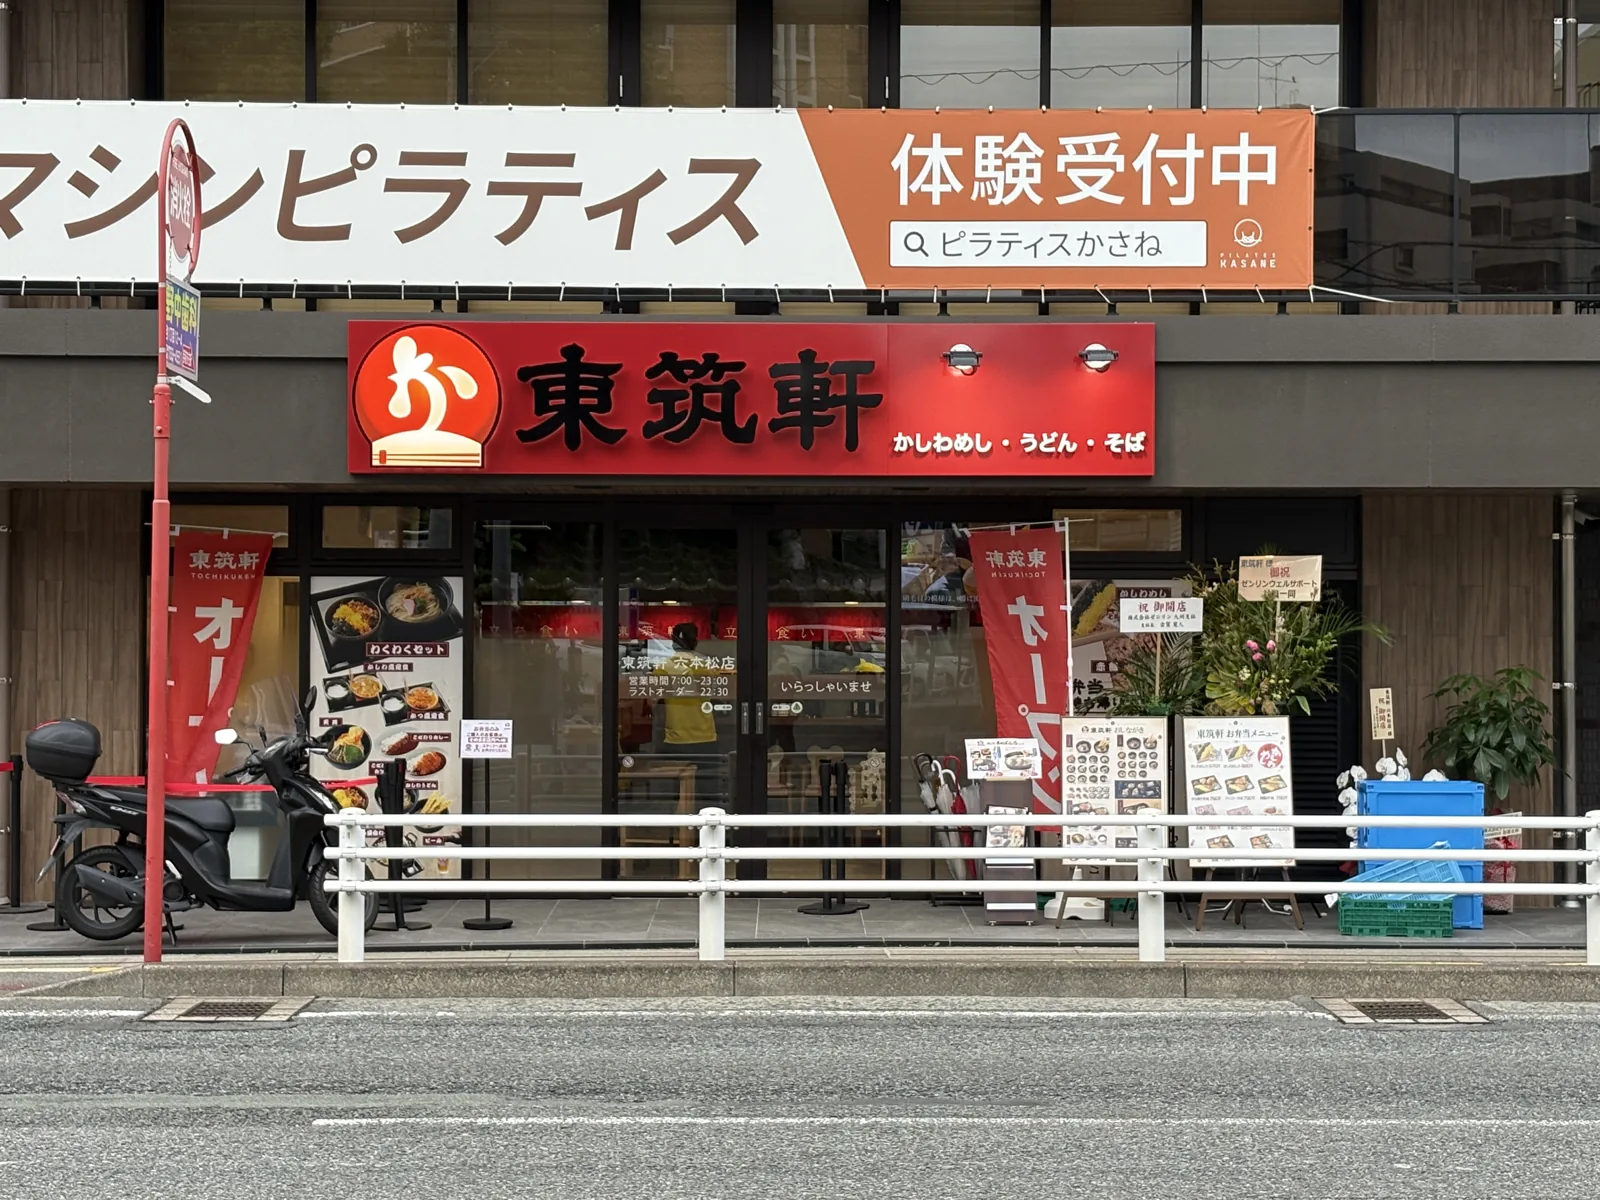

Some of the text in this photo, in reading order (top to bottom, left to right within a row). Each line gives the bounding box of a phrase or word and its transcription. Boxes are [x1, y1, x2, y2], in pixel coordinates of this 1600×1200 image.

[890, 131, 1278, 207] 体験受付中
[0, 143, 762, 252] マシンピラティス
[940, 229, 1163, 259] ピラティスかさね
[1220, 259, 1276, 268] KASANE
[516, 342, 882, 452] 東筑軒
[189, 549, 260, 570] 東筑軒
[191, 572, 256, 580] TOCHIKUKEN
[1270, 566, 1290, 578] 御祝
[1241, 580, 1317, 588] ゼンリンウェルサポート
[1120, 588, 1167, 598] かしわめし
[370, 644, 445, 655] わくわくセット
[620, 656, 736, 670] 東筑軒 六本松店
[628, 675, 669, 686] 営業時間
[628, 687, 729, 697] ラストオーダー 22:30
[781, 680, 872, 693] いらっしゃいませ
[1226, 728, 1278, 739] お弁当メニュー
